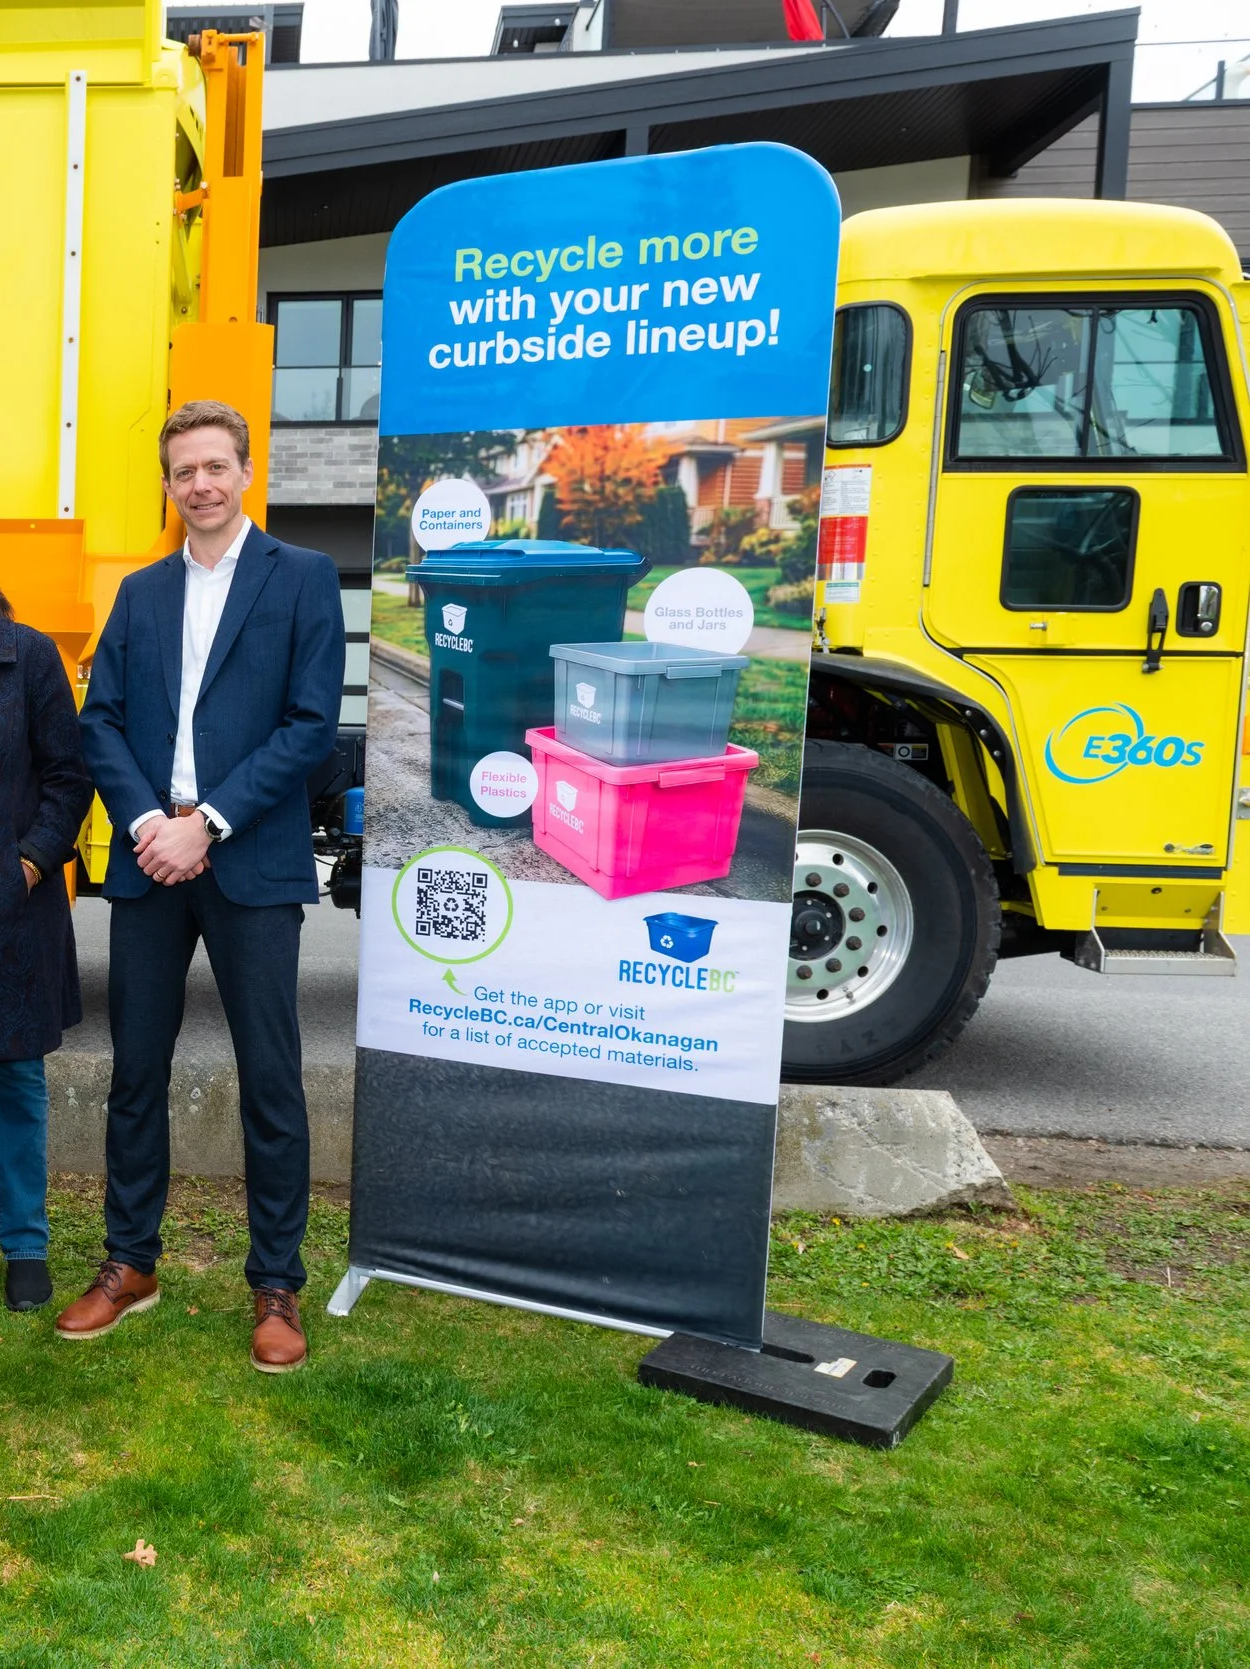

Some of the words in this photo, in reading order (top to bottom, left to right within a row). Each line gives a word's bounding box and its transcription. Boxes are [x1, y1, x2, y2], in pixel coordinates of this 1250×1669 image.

[454, 236, 623, 283] Recycle
[638, 226, 759, 265] more
[449, 288, 536, 325] with
[550, 283, 649, 321] your
[662, 272, 761, 307] new
[428, 325, 611, 370] curbside
[625, 308, 781, 357] lineup!
[419, 519, 483, 531] Containers
[422, 508, 456, 520] Paper
[459, 507, 482, 518] and
[654, 607, 692, 618] Glass
[695, 607, 744, 618] Bottles
[669, 620, 694, 630] and
[697, 620, 727, 631] Jars
[434, 632, 474, 653] RECYCLEBC
[1082, 733, 1206, 768] E360S
[480, 786, 527, 798] Plastics
[481, 771, 527, 784] Flexible
[549, 802, 584, 834] RECYCLEBC
[619, 959, 736, 994] RECYCLEBC
[474, 986, 505, 1004] Get
[510, 990, 538, 1008] the
[543, 997, 578, 1015] app
[584, 1002, 603, 1015] or
[608, 1003, 646, 1021] visit
[408, 998, 719, 1052] RecycleBC.ca/CentralOkanagan
[423, 1021, 446, 1038] for
[450, 1028, 460, 1040] a
[466, 1027, 490, 1044] list
[495, 1033, 513, 1047] of
[517, 1037, 601, 1059] accepted
[607, 1049, 699, 1072] materials.
